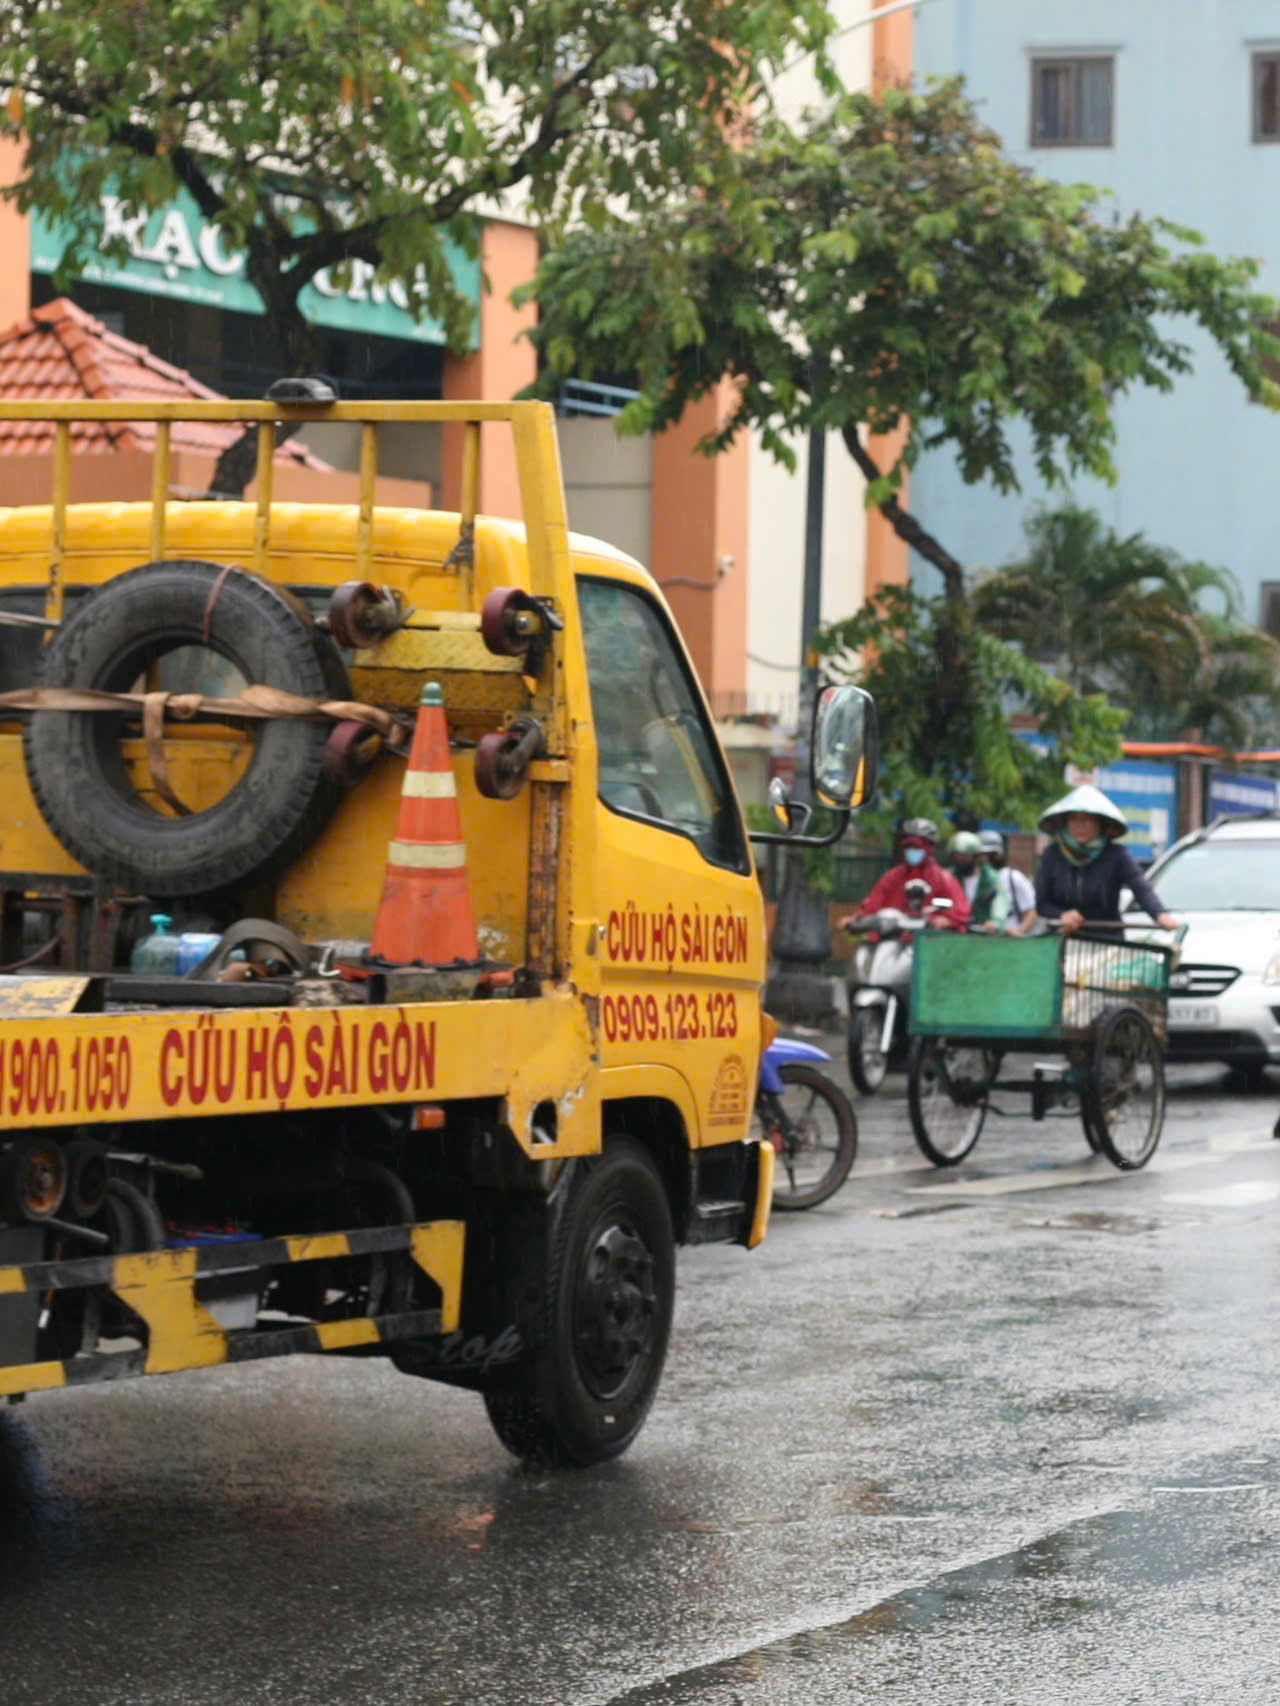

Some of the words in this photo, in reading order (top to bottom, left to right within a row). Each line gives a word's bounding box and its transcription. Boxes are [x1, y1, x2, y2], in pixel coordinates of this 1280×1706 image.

[607, 899, 648, 962] CỨU
[651, 902, 677, 975] HỘ
[680, 902, 710, 963] SÀI
[713, 904, 748, 964] GÒN
[603, 992, 739, 1043] 0909.123.123
[160, 1014, 237, 1107] CỨU
[244, 1010, 296, 1112] HỘ
[303, 1010, 360, 1098] SÀI
[368, 1007, 436, 1094] GÒN
